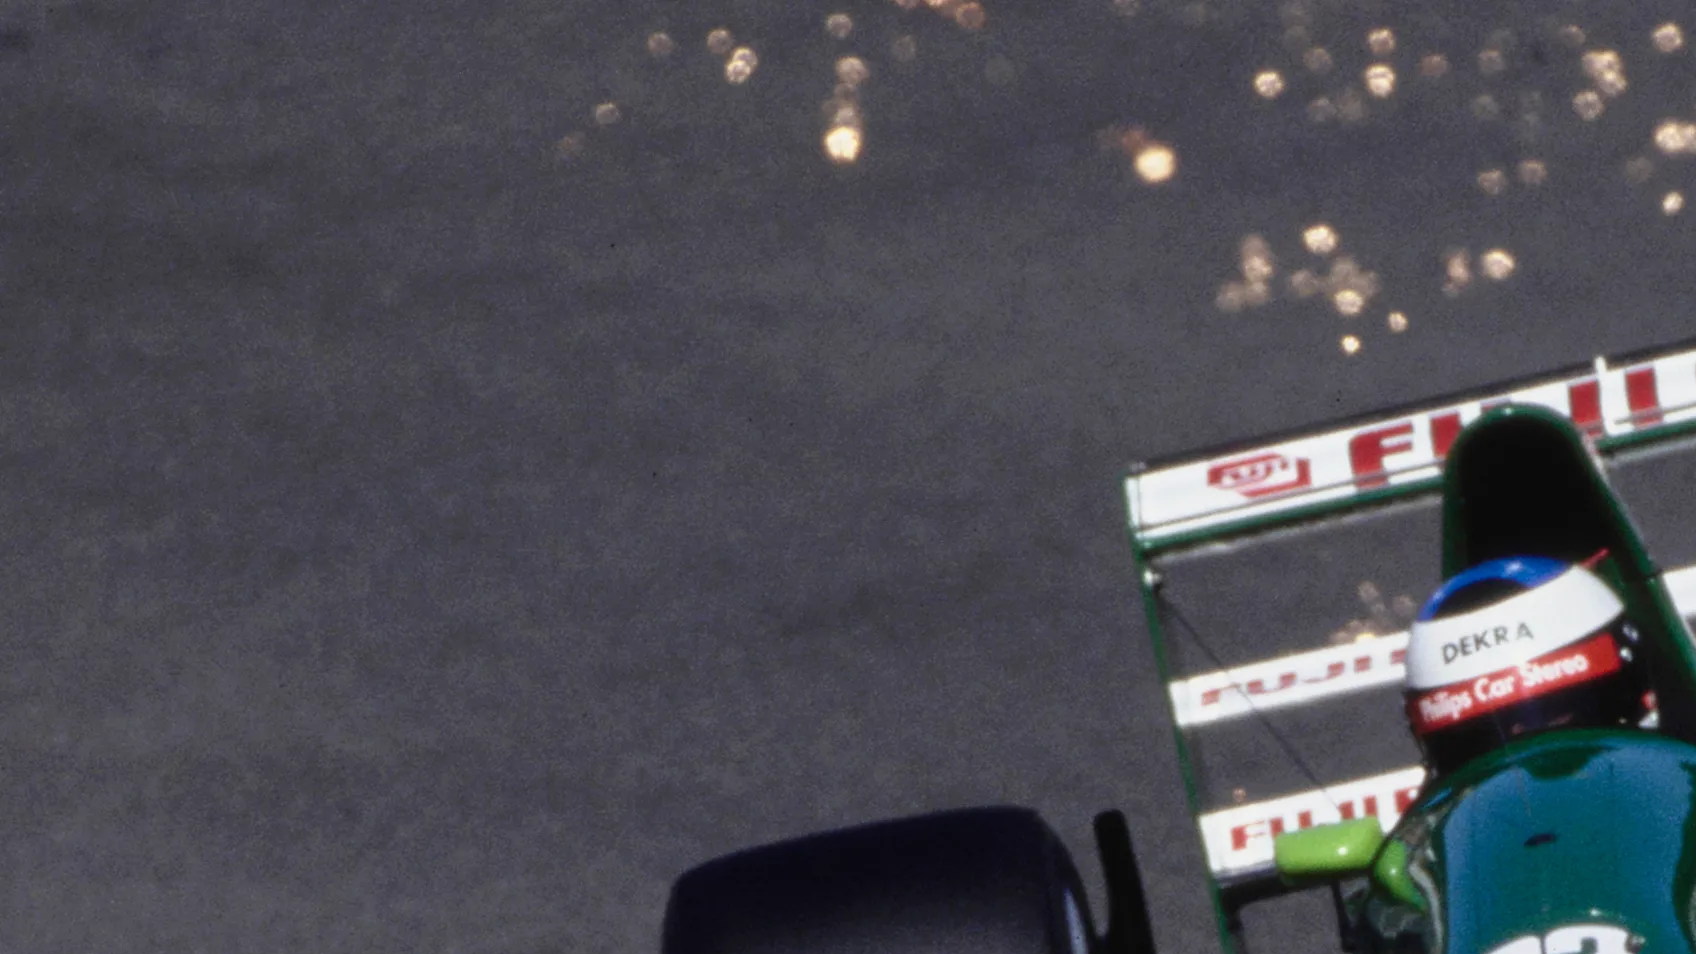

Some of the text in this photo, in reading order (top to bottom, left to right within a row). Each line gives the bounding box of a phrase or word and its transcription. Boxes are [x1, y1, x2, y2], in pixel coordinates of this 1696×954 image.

[1441, 621, 1535, 665] DEKRA
[1474, 674, 1515, 702] Car
[1520, 652, 1590, 688] Stereo
